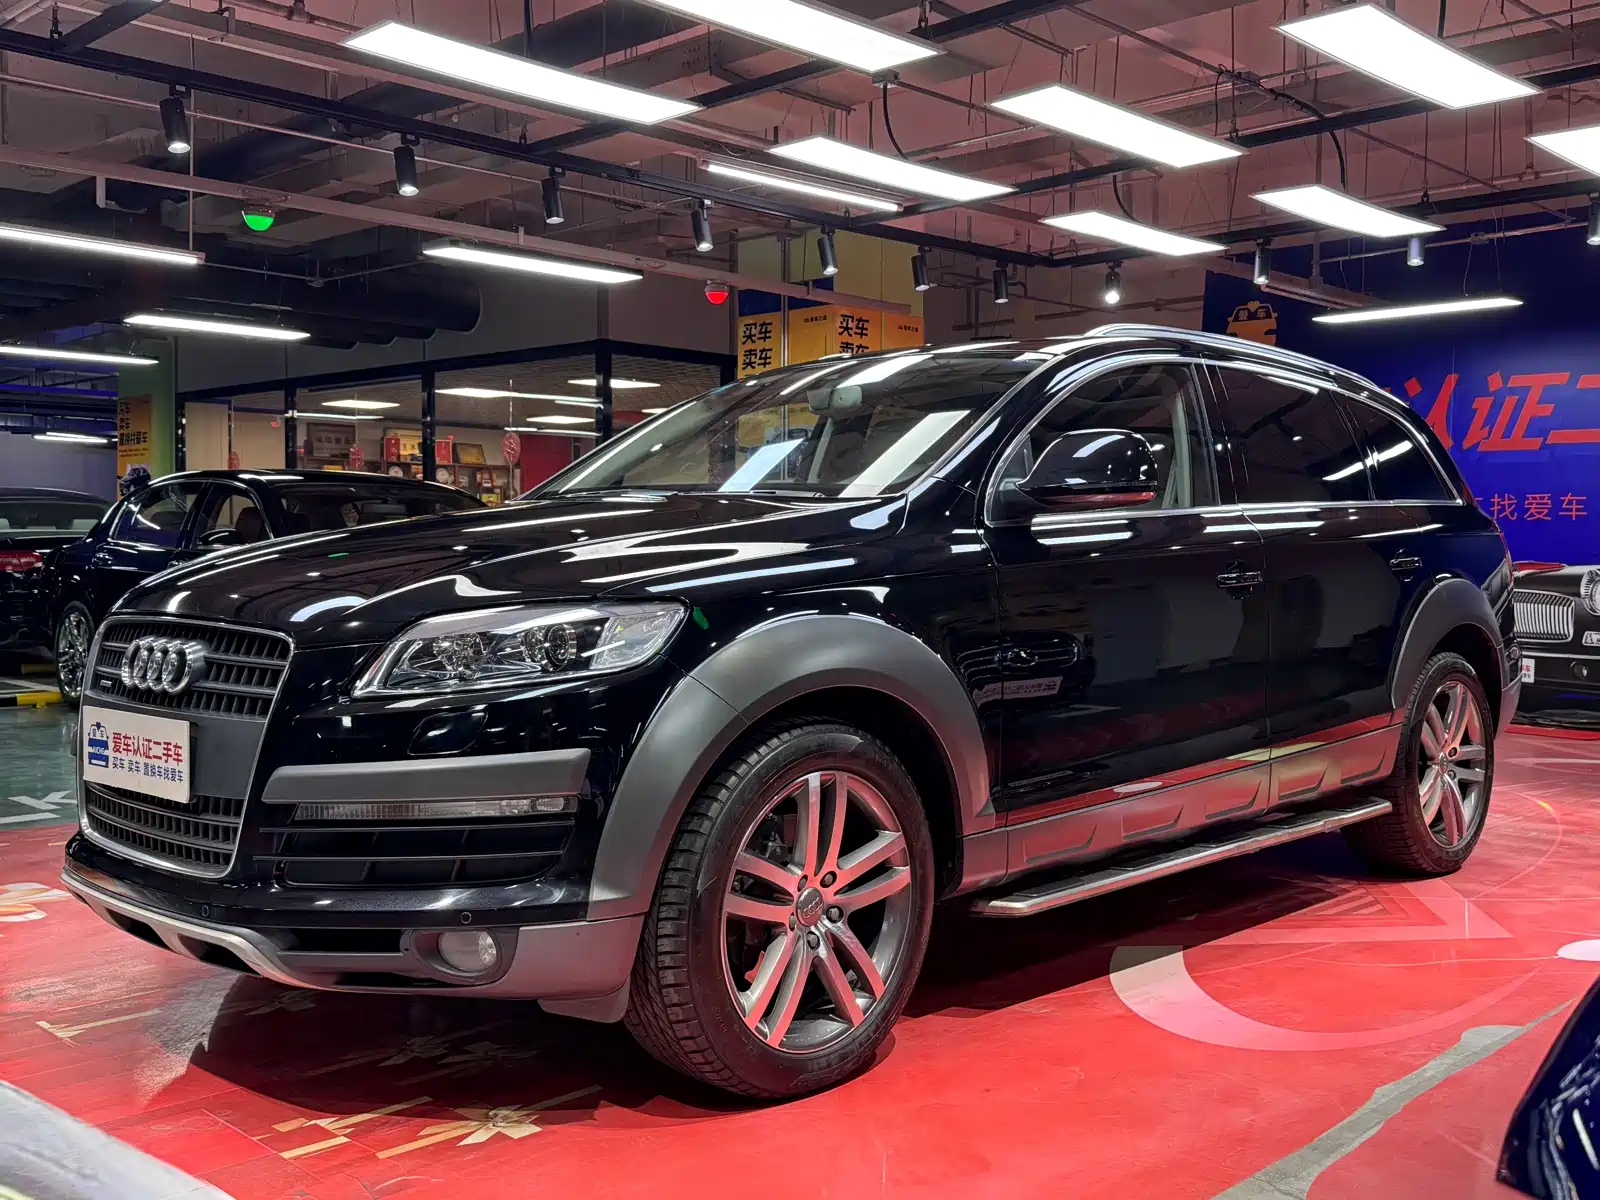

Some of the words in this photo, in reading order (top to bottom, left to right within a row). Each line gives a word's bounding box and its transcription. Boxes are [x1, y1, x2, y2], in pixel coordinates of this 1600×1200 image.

[741, 321, 773, 345] 买车
[838, 313, 870, 339] 买车
[741, 347, 773, 371] 卖车
[1384, 371, 1600, 452] 认证二
[1474, 492, 1588, 521] 找爱车
[112, 731, 184, 767] 爱车认证二手车
[112, 756, 126, 772] 买车
[127, 759, 141, 775] 卖车
